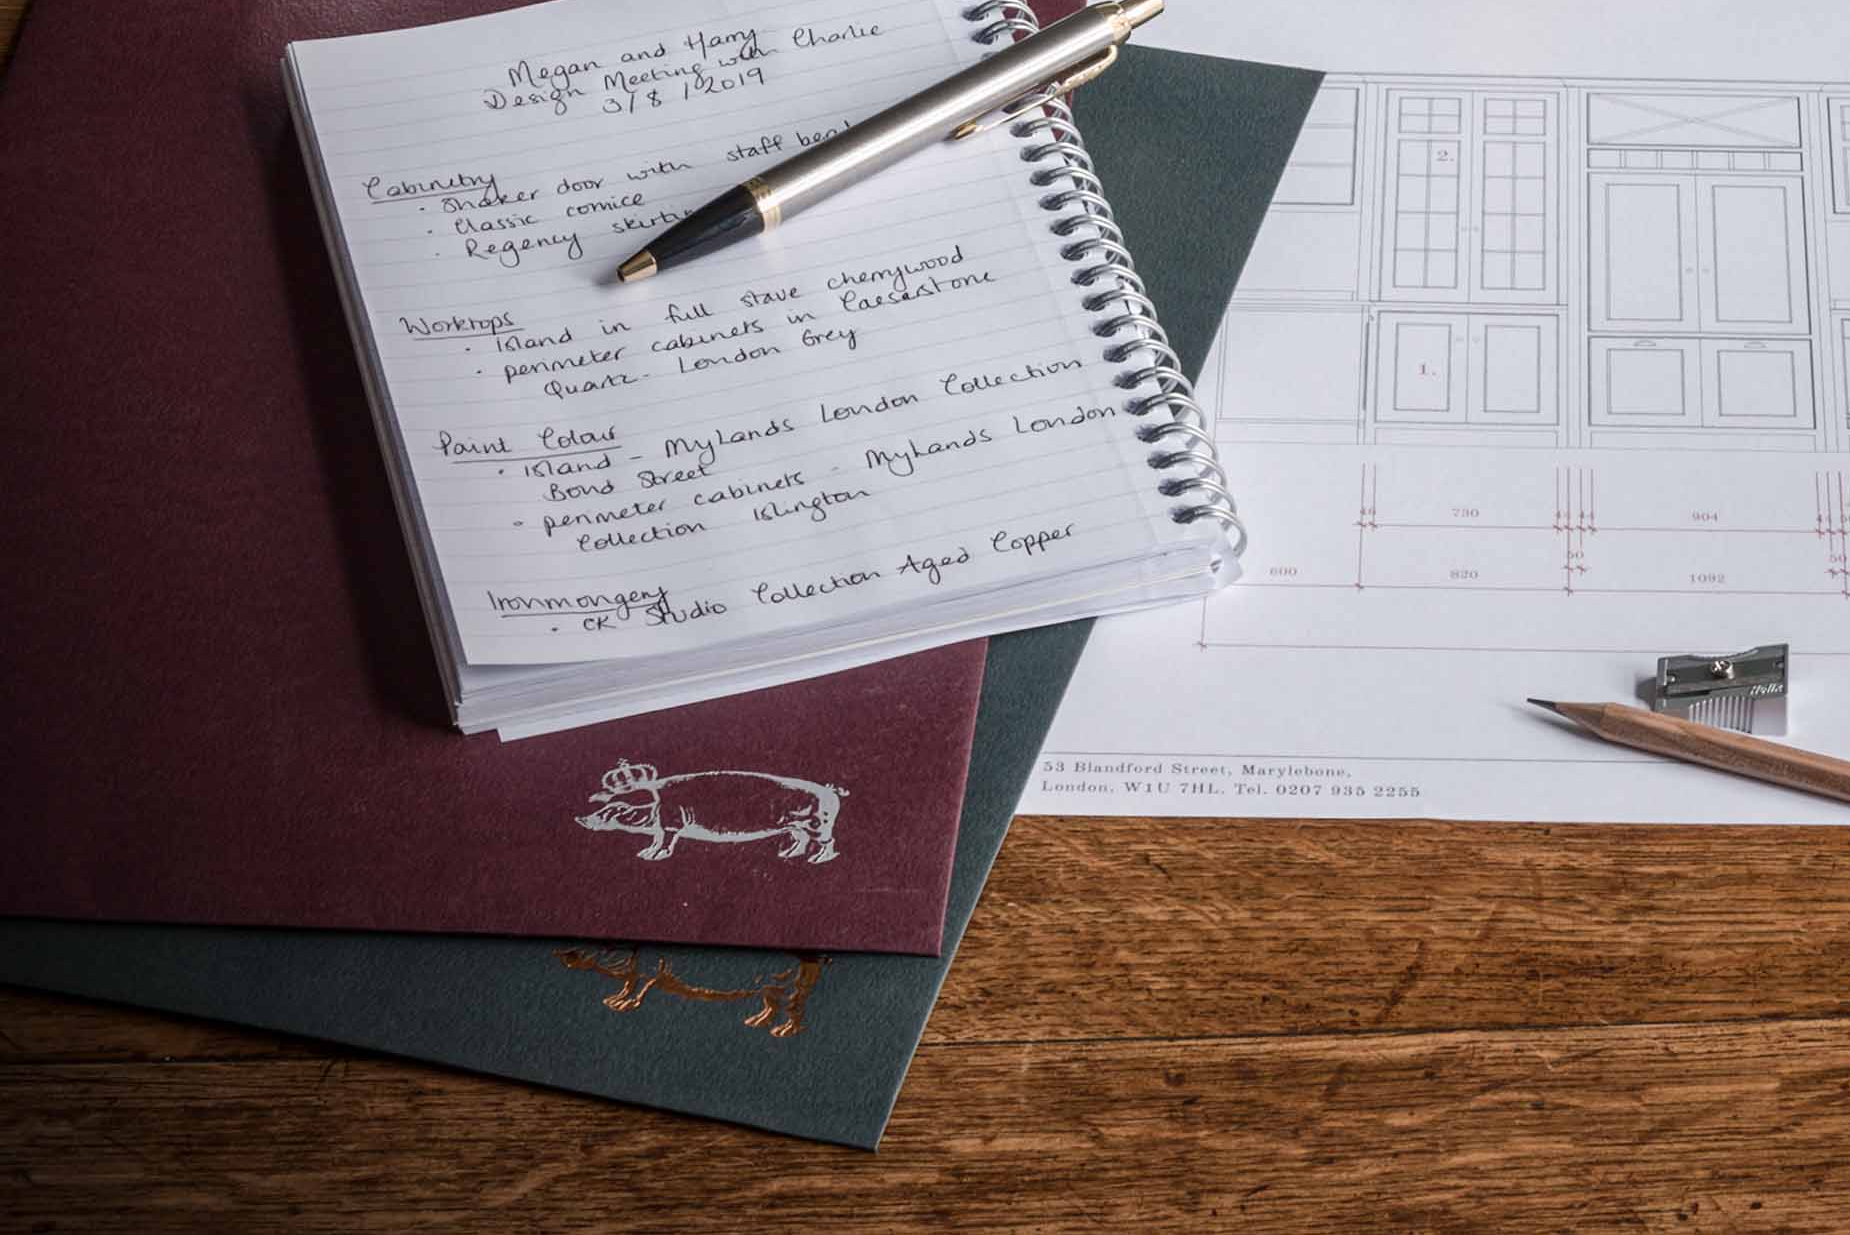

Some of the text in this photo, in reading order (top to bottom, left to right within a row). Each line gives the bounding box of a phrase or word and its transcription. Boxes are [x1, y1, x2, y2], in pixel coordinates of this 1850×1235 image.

[483, 84, 585, 116] Design
[604, 63, 706, 91] Meeting
[792, 23, 885, 48] Charlie
[508, 57, 600, 90] Megan
[620, 42, 667, 65] and
[556, 175, 605, 194] door
[626, 160, 692, 180] with
[725, 133, 783, 162] staff
[566, 191, 645, 217] cornice
[465, 229, 584, 267] Regency
[400, 311, 515, 336] Worktops
[504, 270, 997, 383] perimeter cabinets in Caesarstone
[600, 320, 631, 336] in
[664, 302, 713, 326] full
[740, 285, 799, 308] stave
[678, 343, 782, 374] London
[801, 327, 858, 350] Grey
[820, 393, 919, 423] London
[940, 359, 1083, 397] Collection
[432, 425, 617, 458] Paint Colour
[543, 499, 665, 537] perimeter
[693, 471, 806, 507] cabinets
[1013, 404, 1116, 434] London
[543, 463, 713, 501] Bond Street
[577, 520, 707, 553] Collection
[645, 601, 728, 628] Studio
[752, 569, 882, 605] Collection
[898, 546, 971, 585] Aged
[991, 521, 1076, 556] Copper
[1043, 761, 1352, 778] 53 Blandford Street, Marylebone,
[1124, 781, 1170, 794] W1U
[1233, 783, 1269, 796] Tel.
[1275, 784, 1323, 797] 0207
[1330, 785, 1366, 797] 935
[1373, 785, 1421, 798] 2255
